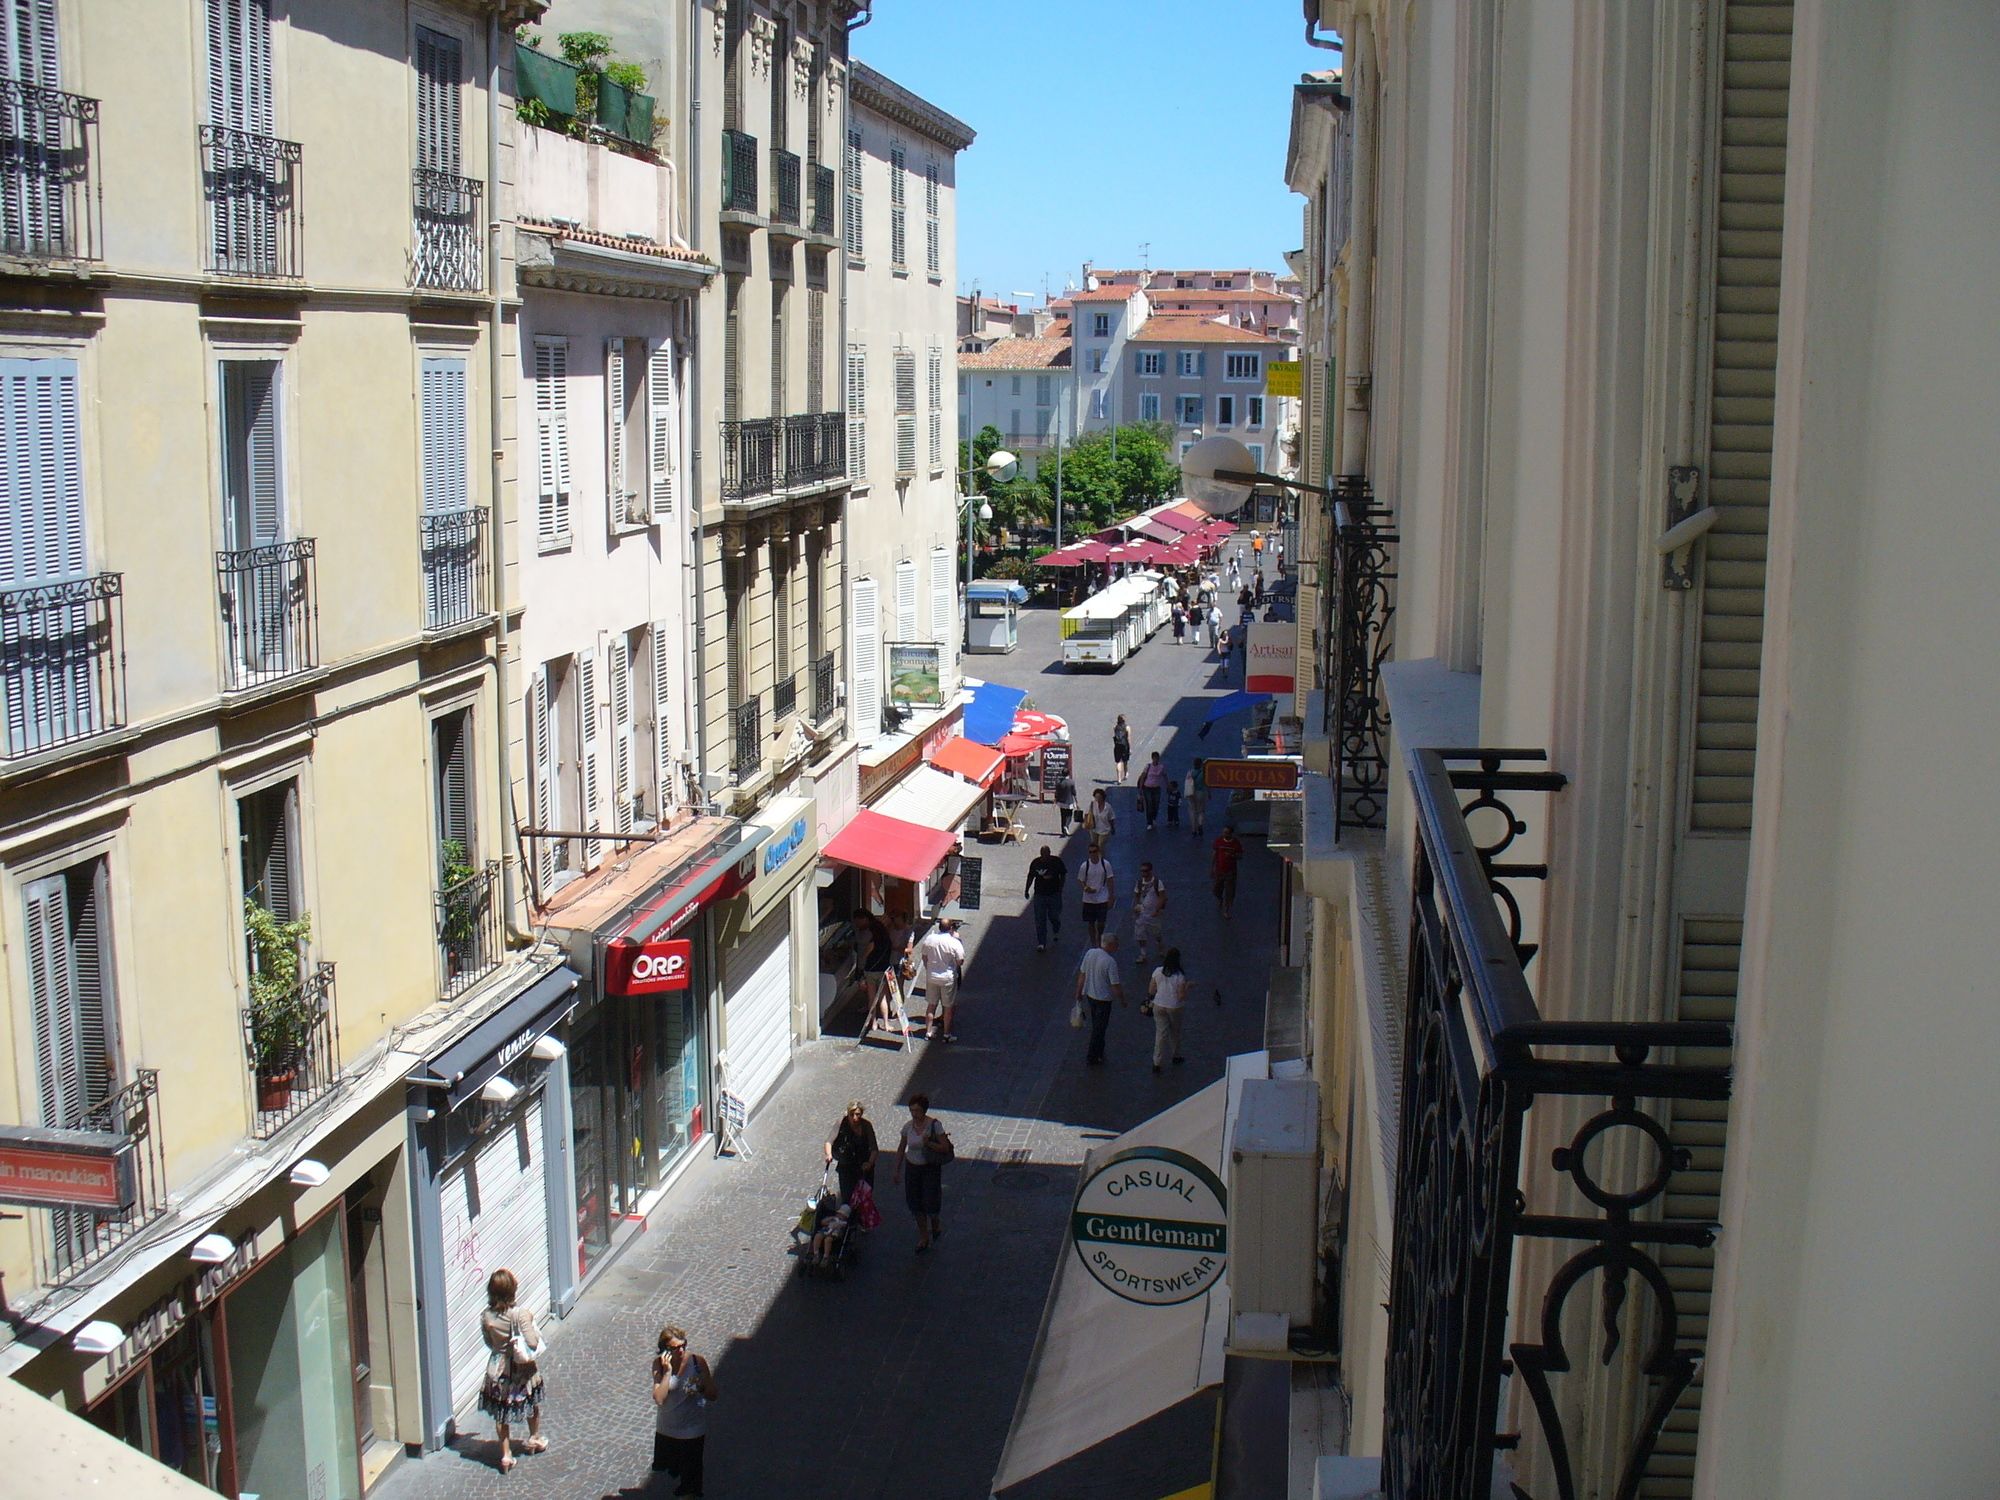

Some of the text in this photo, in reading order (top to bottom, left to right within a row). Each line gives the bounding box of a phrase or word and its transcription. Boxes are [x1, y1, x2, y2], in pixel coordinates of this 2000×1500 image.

[1215, 768, 1286, 784] NICOLAS
[632, 955, 683, 979] ORP
[19, 1165, 108, 1187] manoukian
[1107, 1170, 1195, 1203] CASUAL
[1086, 1217, 1221, 1248] Gentleman'
[1093, 1250, 1216, 1294] SPORTSWEAR
